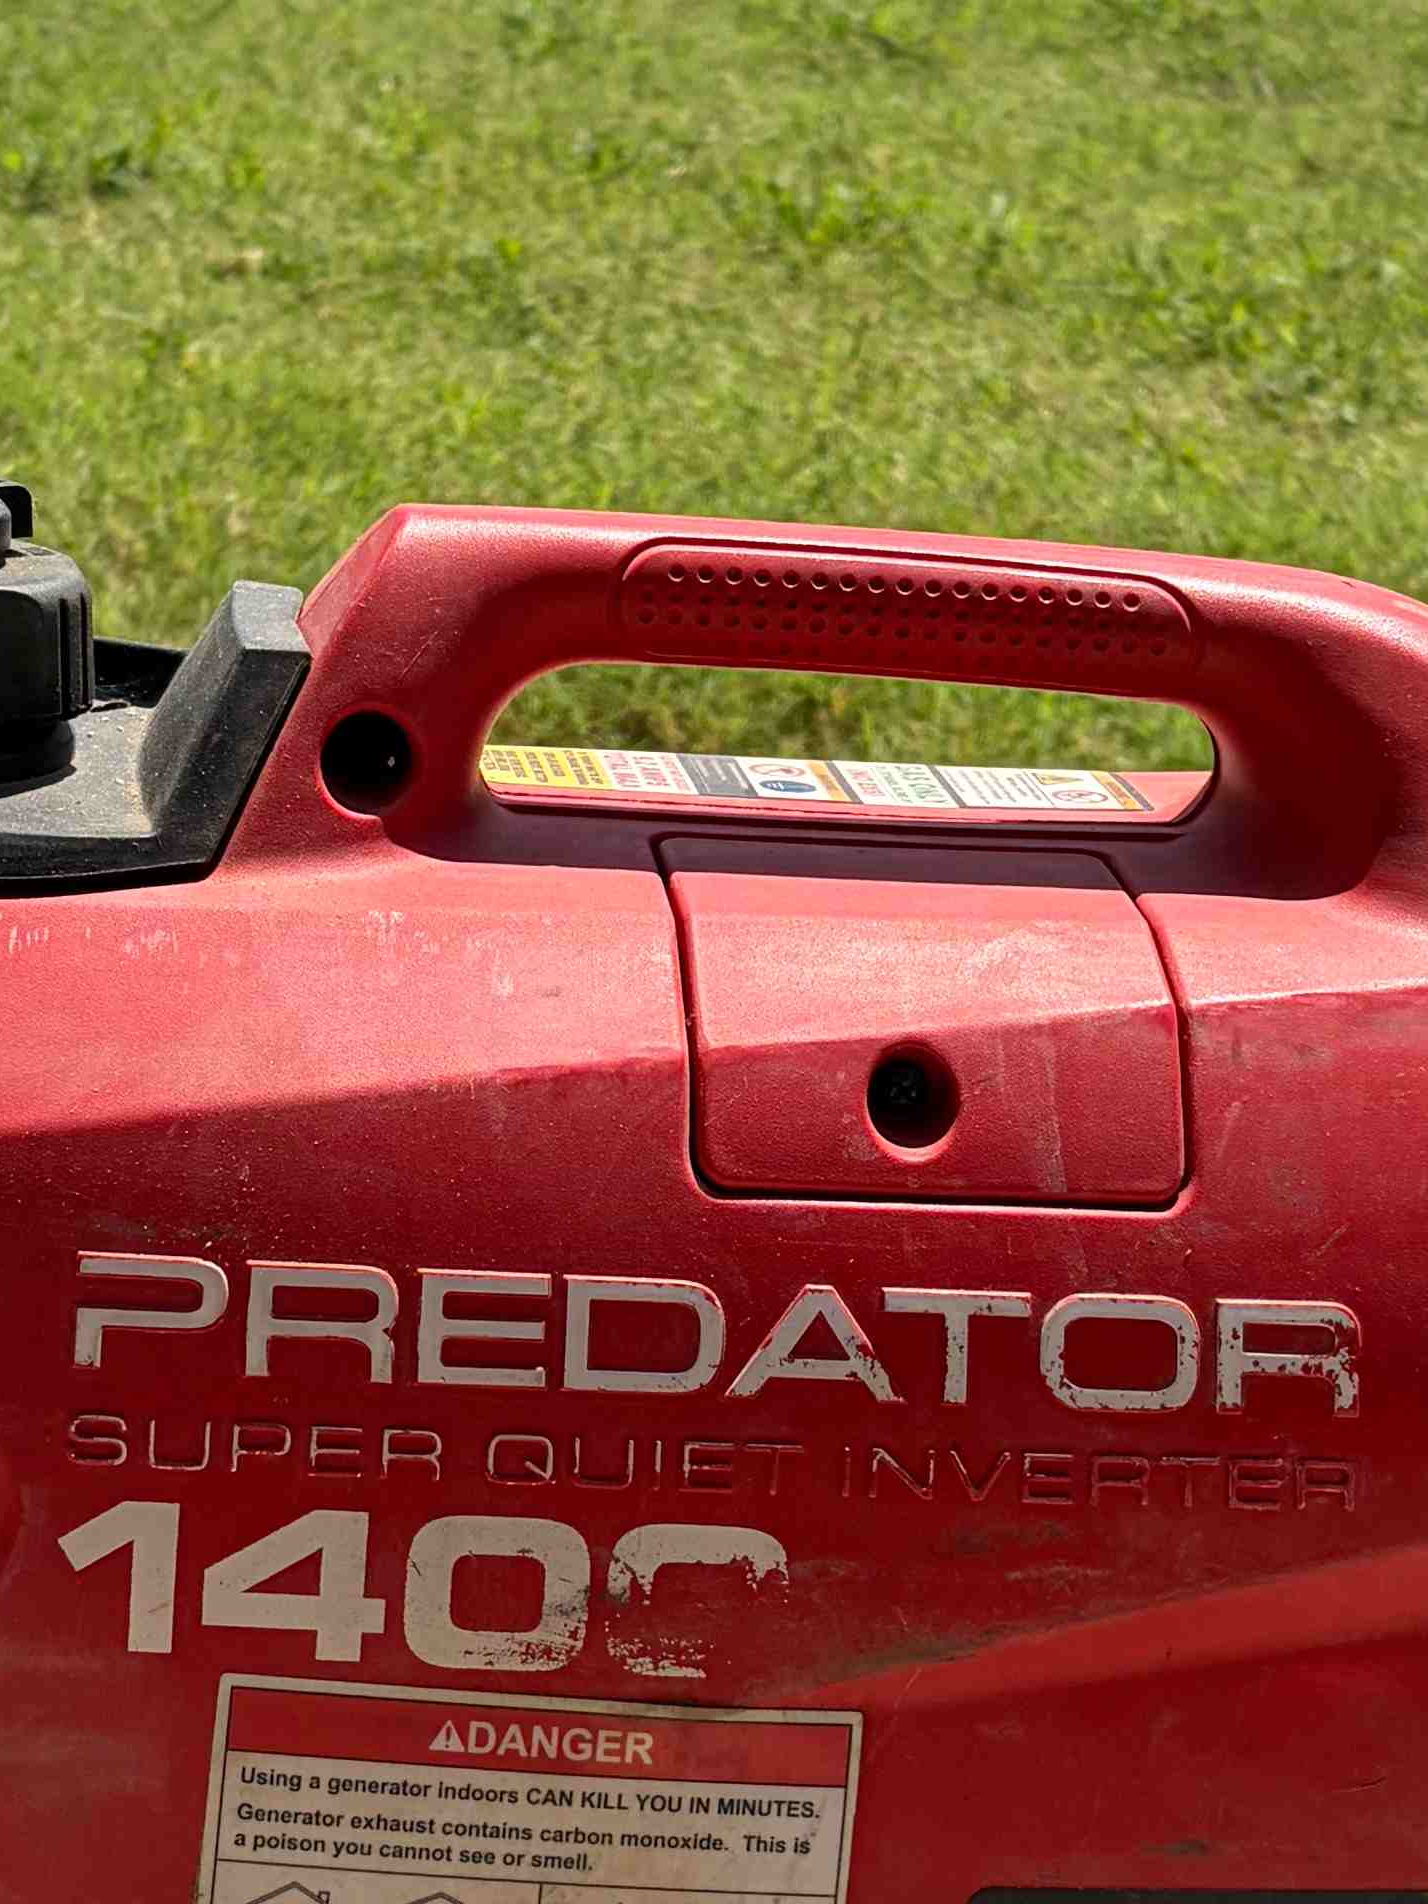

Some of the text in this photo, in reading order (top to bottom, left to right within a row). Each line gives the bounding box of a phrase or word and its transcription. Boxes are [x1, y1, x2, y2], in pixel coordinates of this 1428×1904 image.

[73, 1250, 1361, 1417] PREDATOR
[69, 1413, 1357, 1512] SUPER QUIET INVERTER
[467, 1720, 653, 1765] DANGER
[240, 1766, 821, 1818] Using a generator indoors CAN KILL YOU IN MINUTES.
[234, 1829, 593, 1871] a poison you cannot see or smell.
[236, 1802, 811, 1854] Generator exhaust contains carbon monoxide. This is
